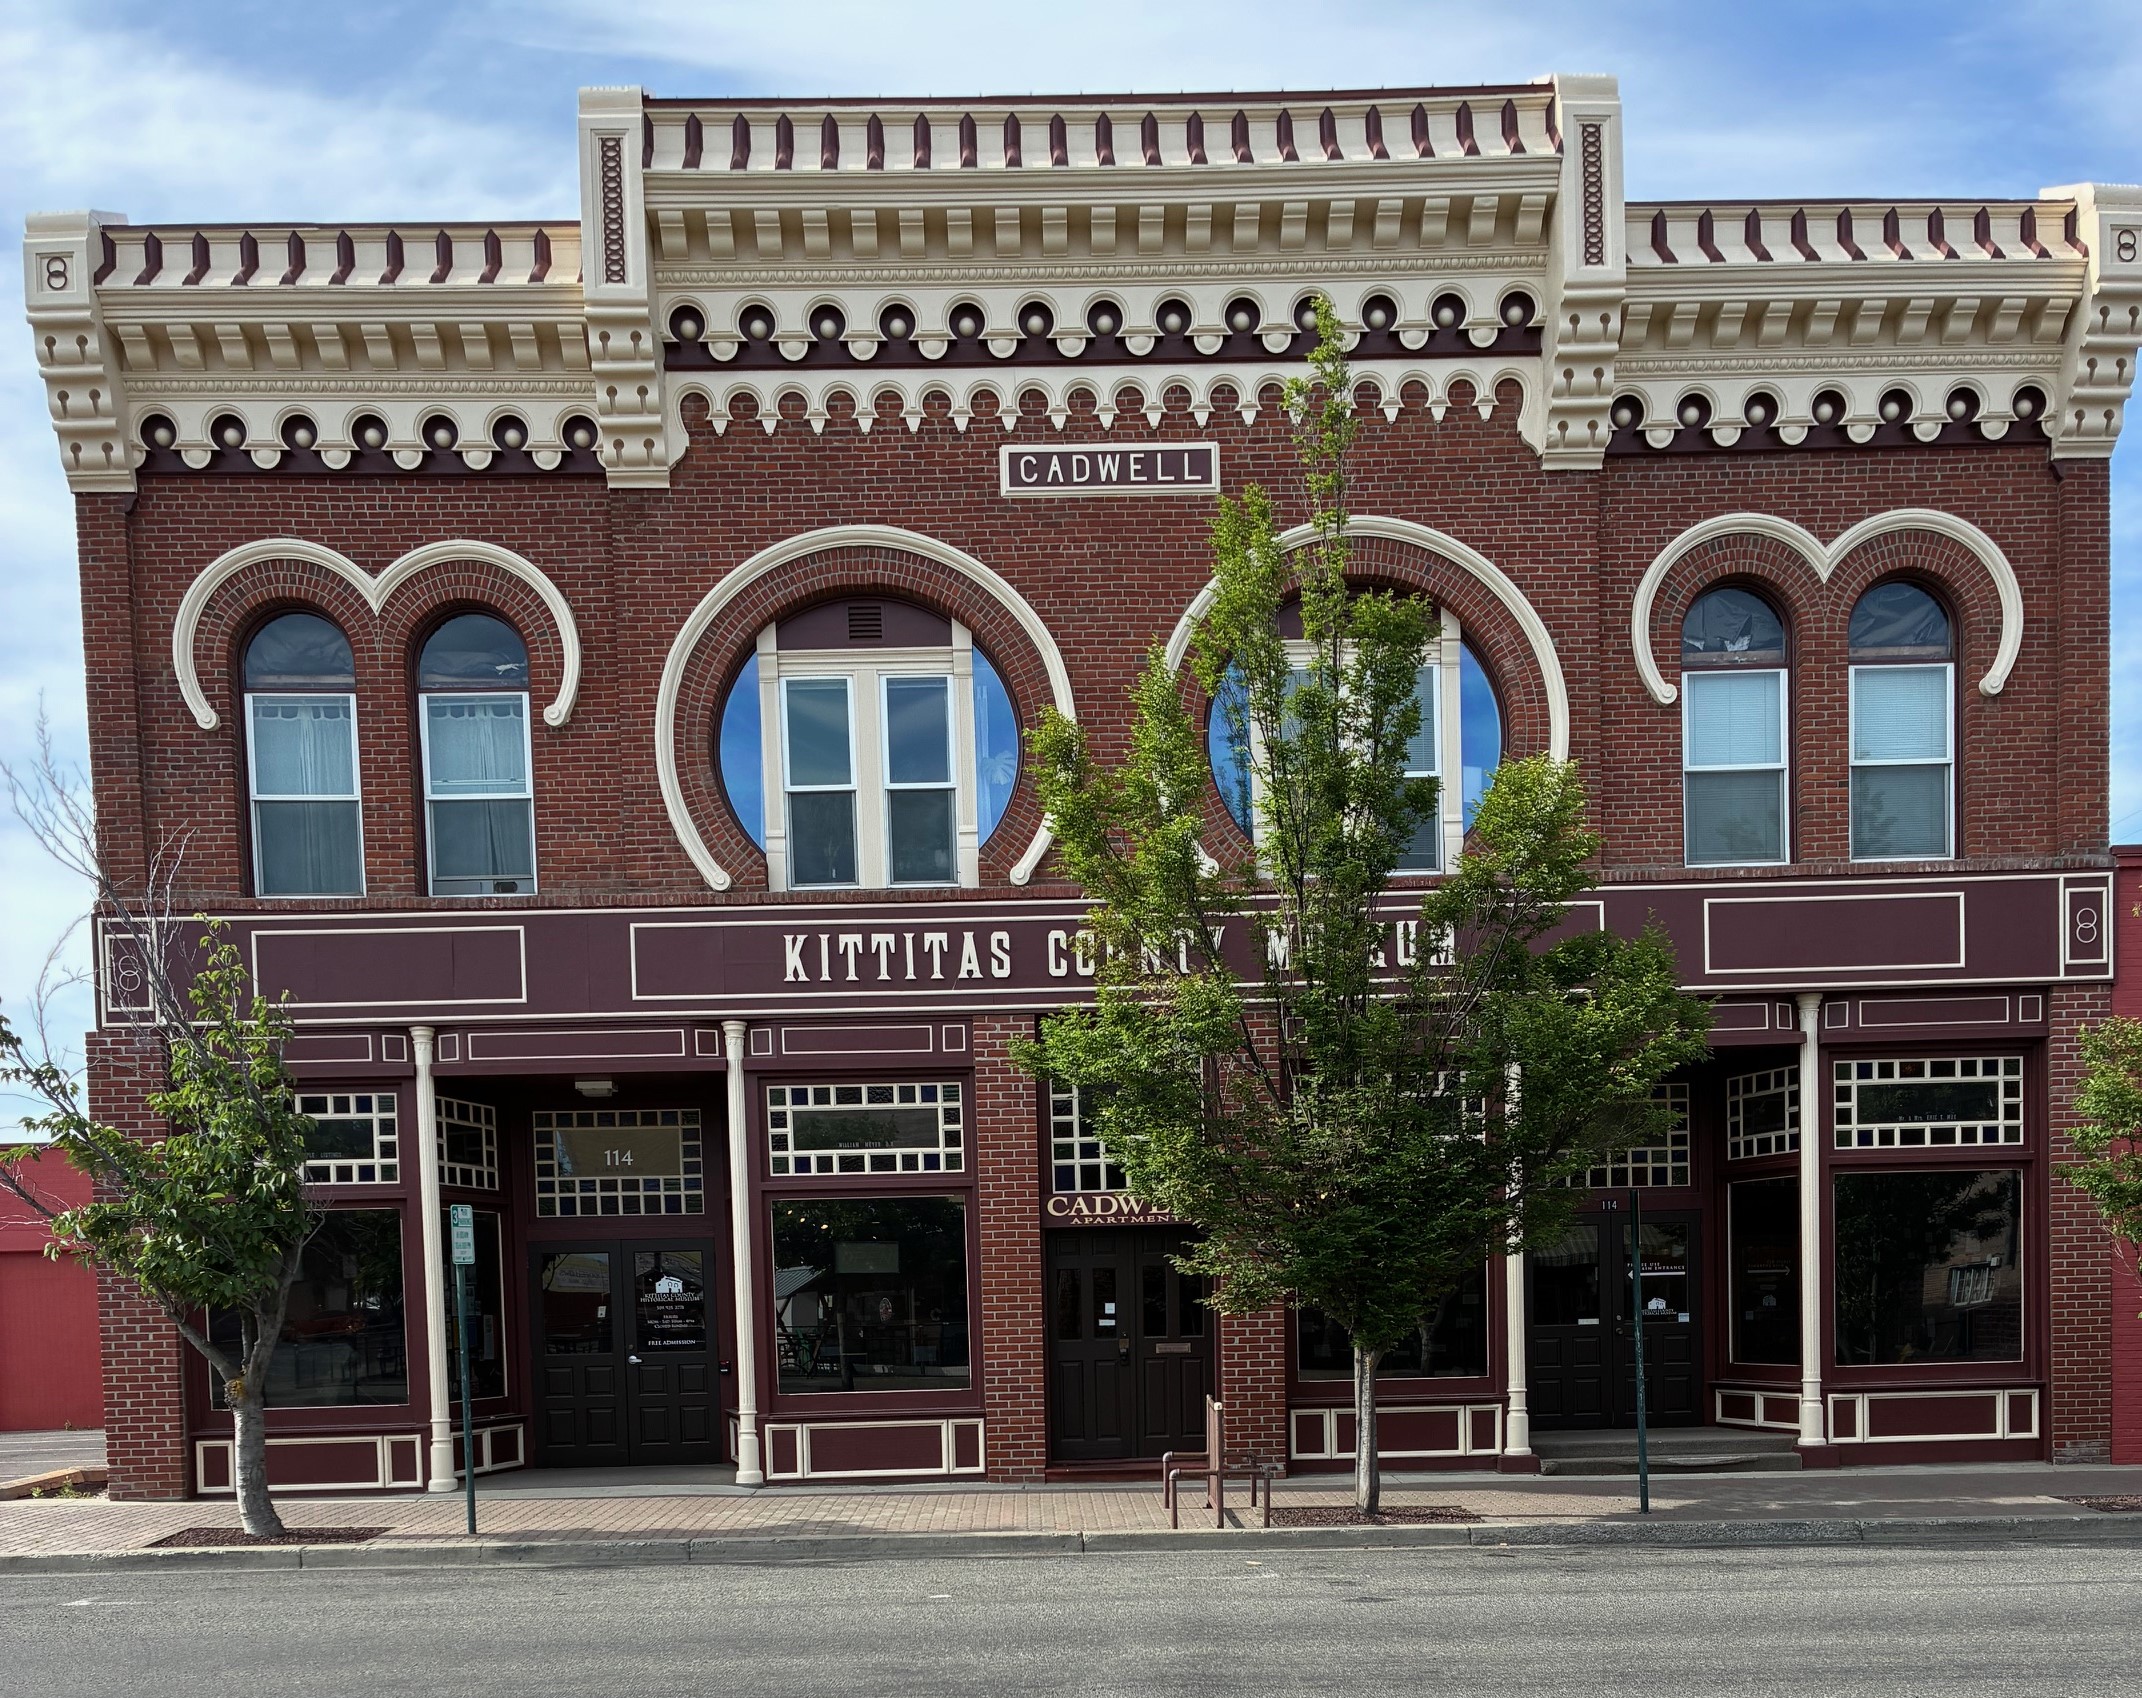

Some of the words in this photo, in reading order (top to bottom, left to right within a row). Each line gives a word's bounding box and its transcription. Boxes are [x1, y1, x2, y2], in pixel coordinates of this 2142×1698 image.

[1019, 452, 1202, 483] CADWELL
[782, 930, 1011, 983] KITTITAS
[838, 1141, 860, 1149] WILLIAM
[603, 1149, 634, 1167] 114
[1602, 1200, 1617, 1211] 114
[452, 1209, 458, 1224] 3
